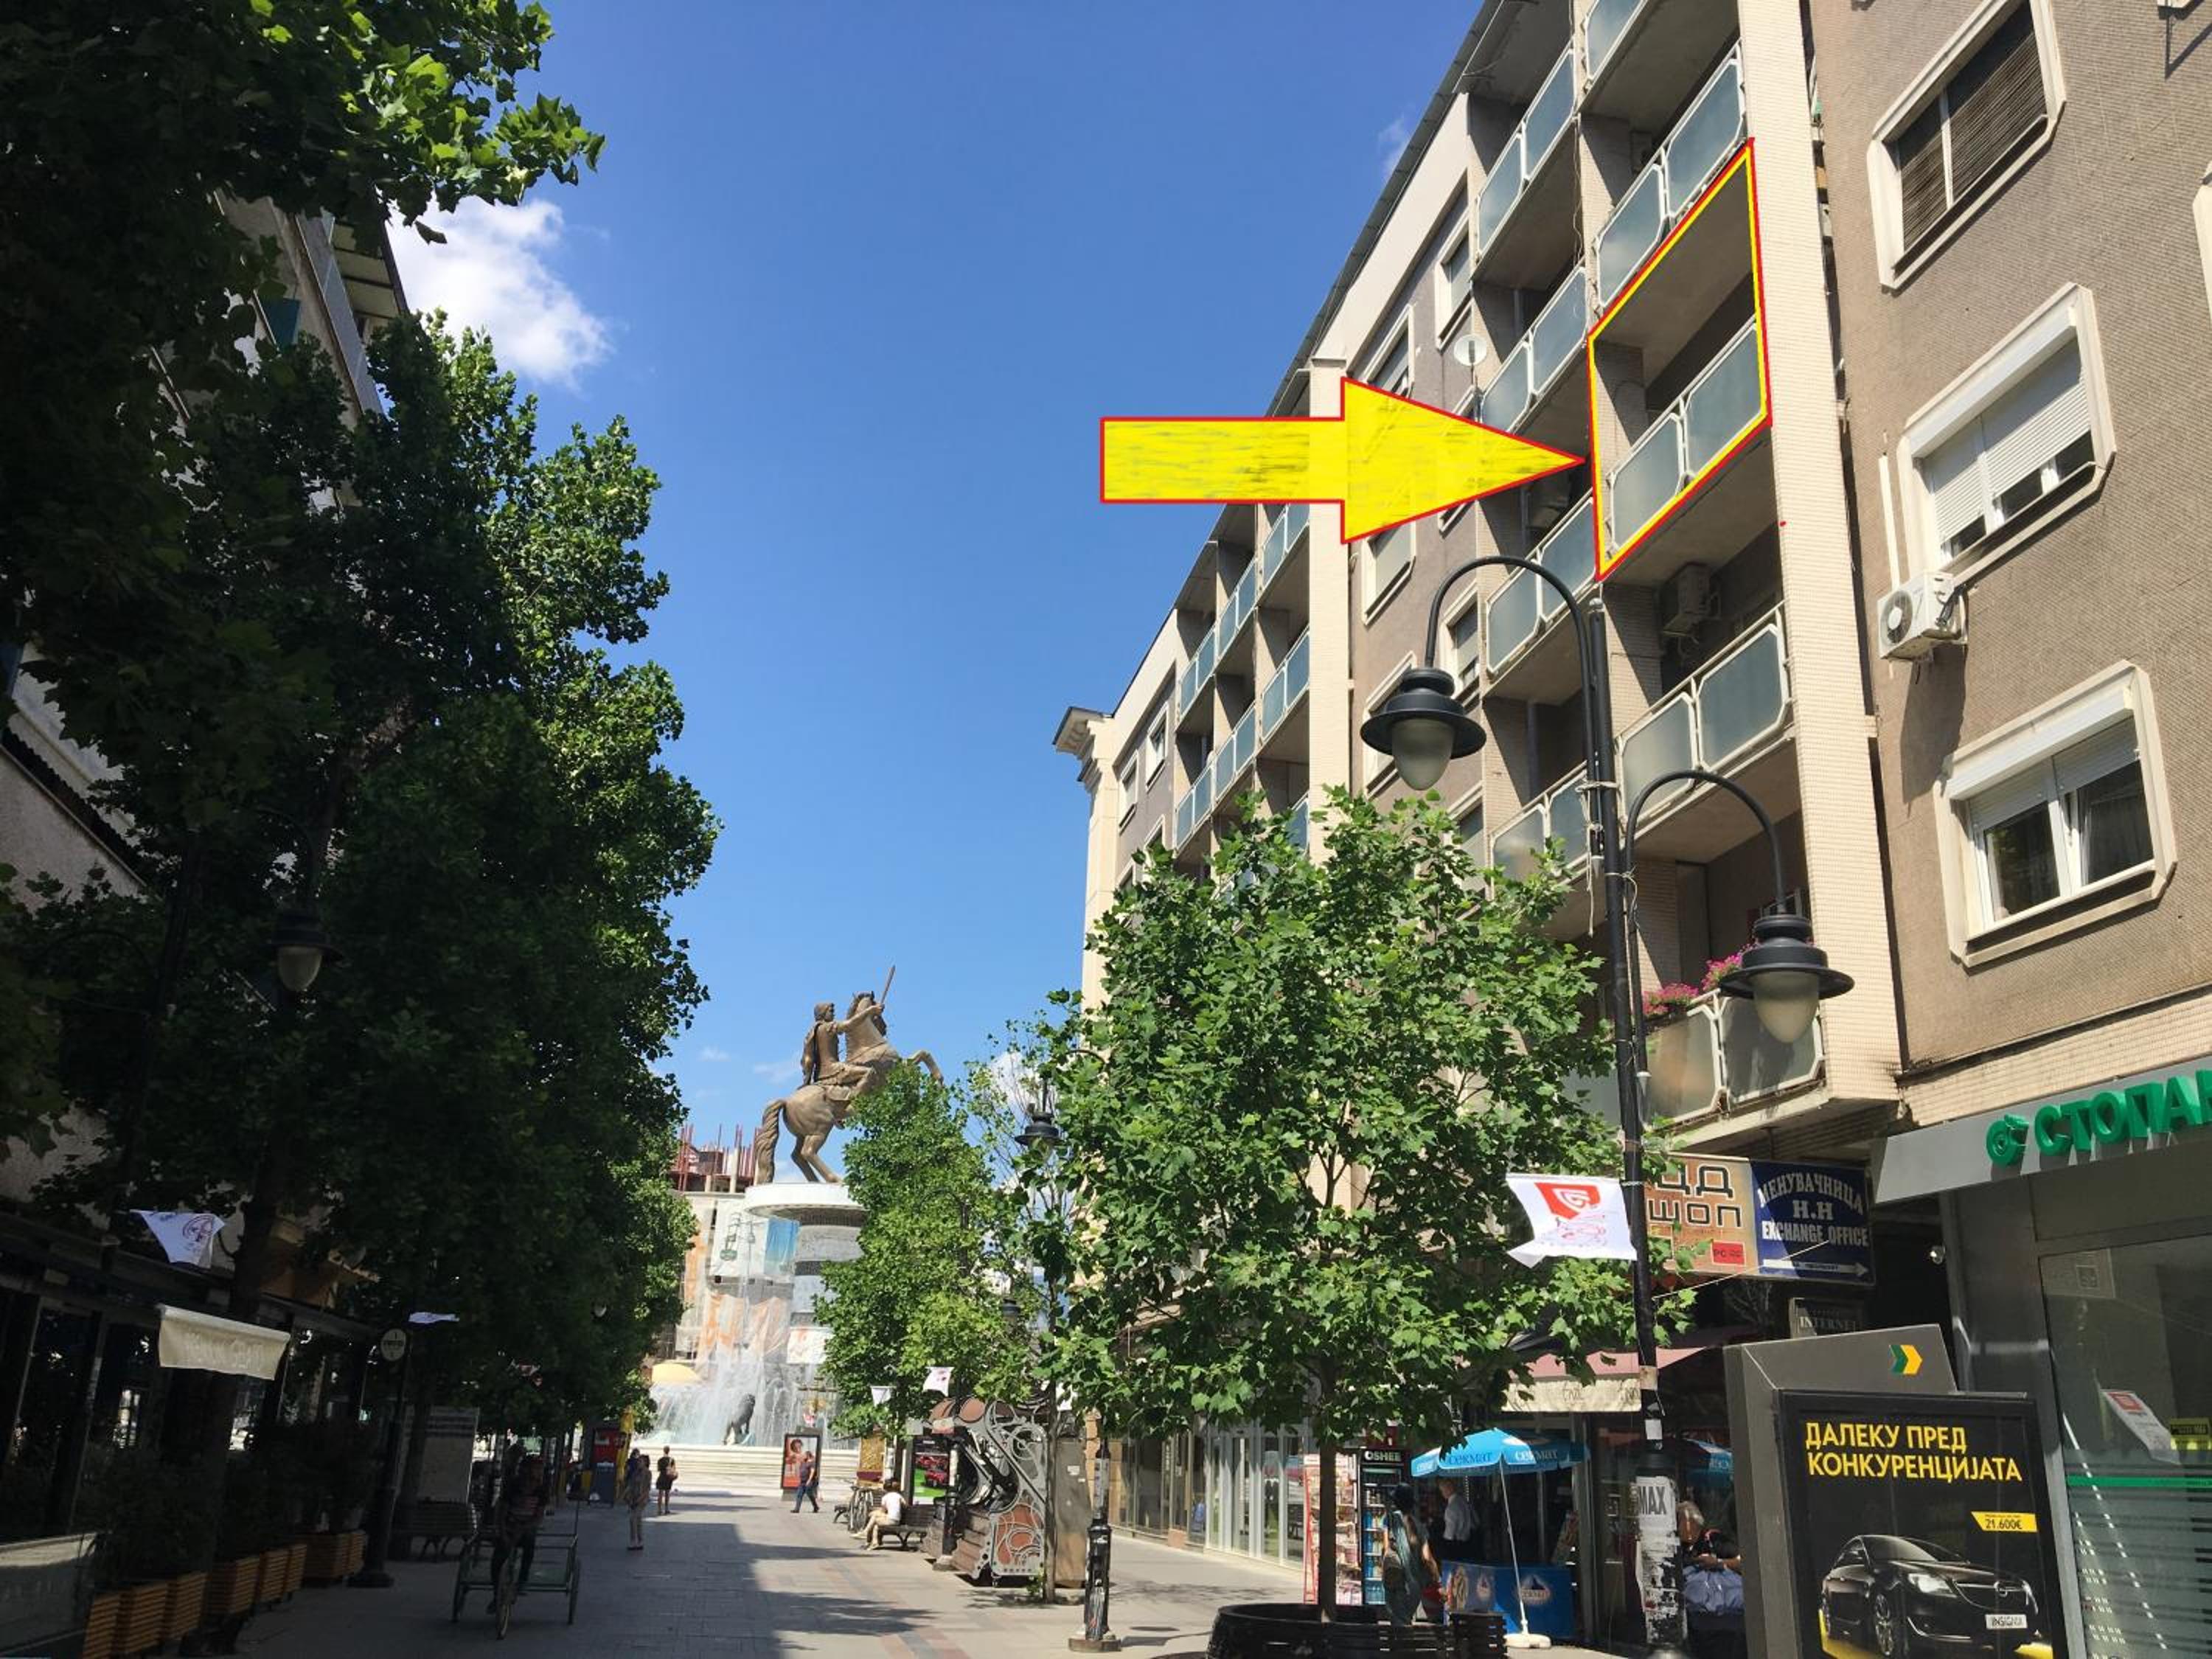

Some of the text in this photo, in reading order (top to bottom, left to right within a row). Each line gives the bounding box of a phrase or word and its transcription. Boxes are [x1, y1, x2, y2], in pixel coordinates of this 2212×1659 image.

[1648, 1199, 1742, 1228] ШОП
[1761, 1220, 1869, 1247] EXCHANGE OFFICE
[1805, 1422, 1967, 1455] ДАЛЕКУ ПРЕД
[1808, 1451, 2023, 1483] КОНКУРЕНЦИЈАТА
